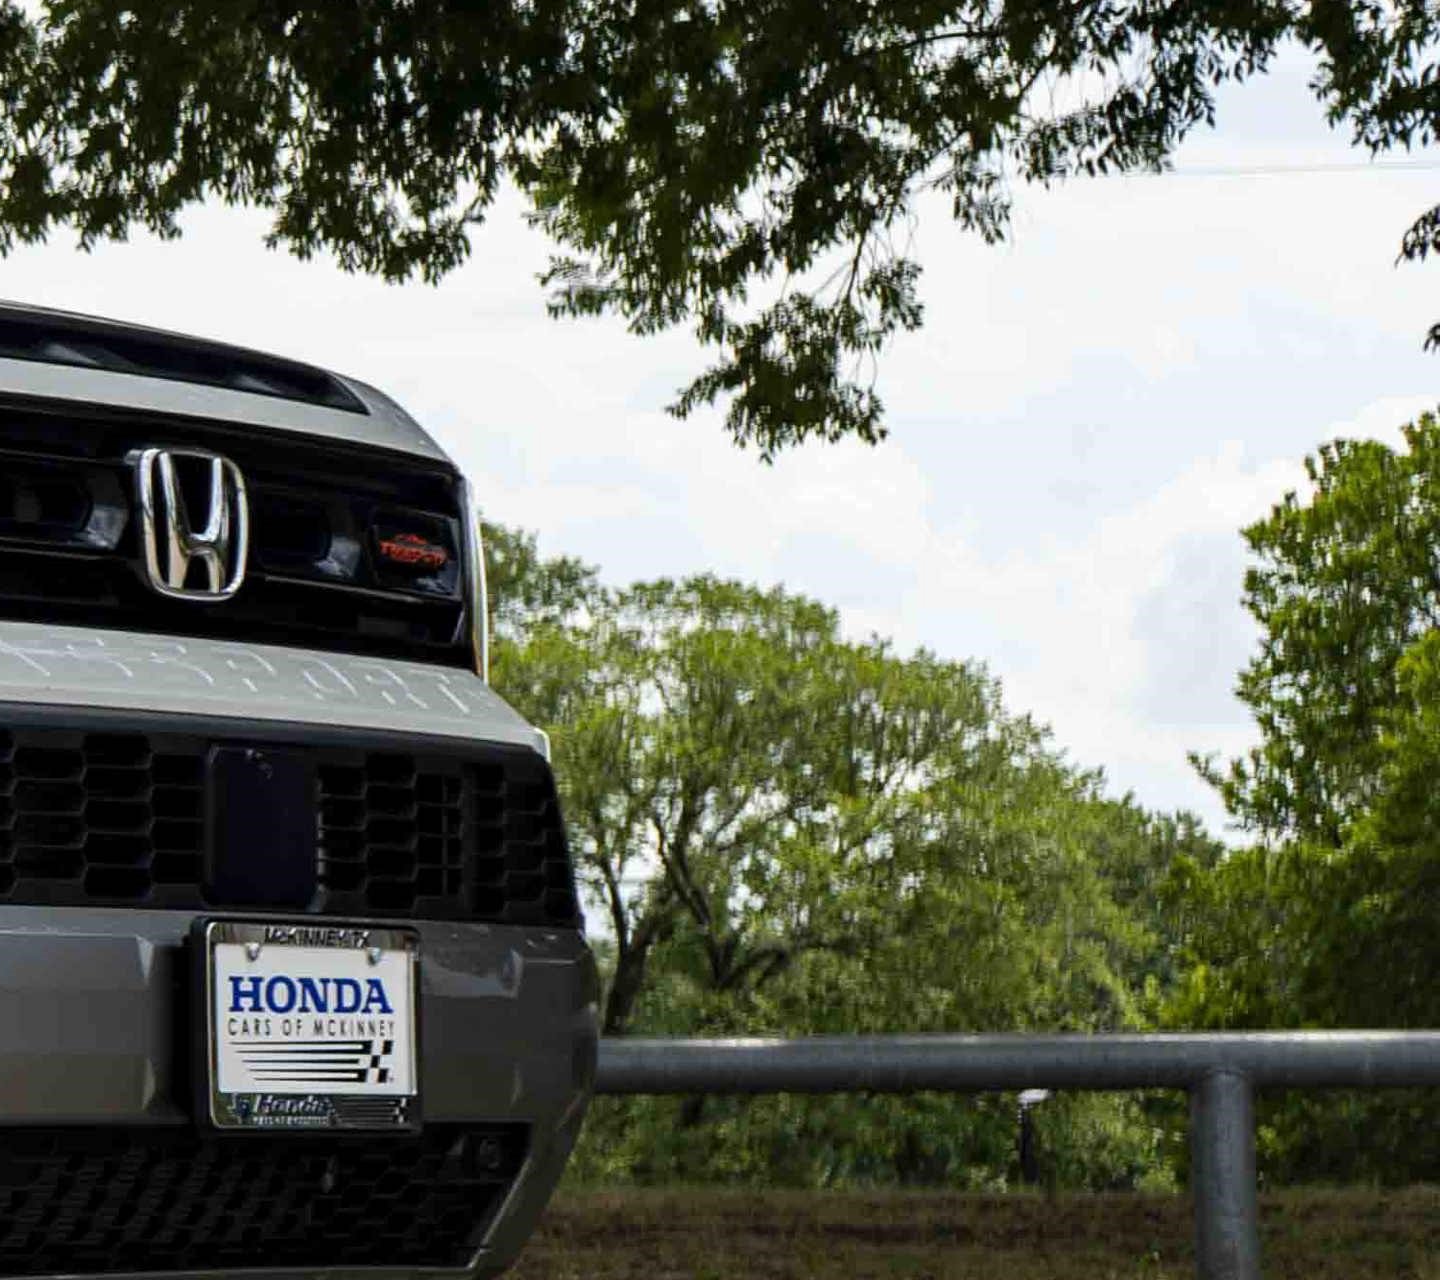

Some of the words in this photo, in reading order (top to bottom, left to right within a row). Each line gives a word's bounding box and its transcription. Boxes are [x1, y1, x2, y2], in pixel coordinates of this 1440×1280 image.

[228, 975, 394, 1015] HONDA
[227, 1017, 271, 1037] CARS
[282, 1018, 303, 1037] OF
[314, 1019, 395, 1038] MCKINNEY
